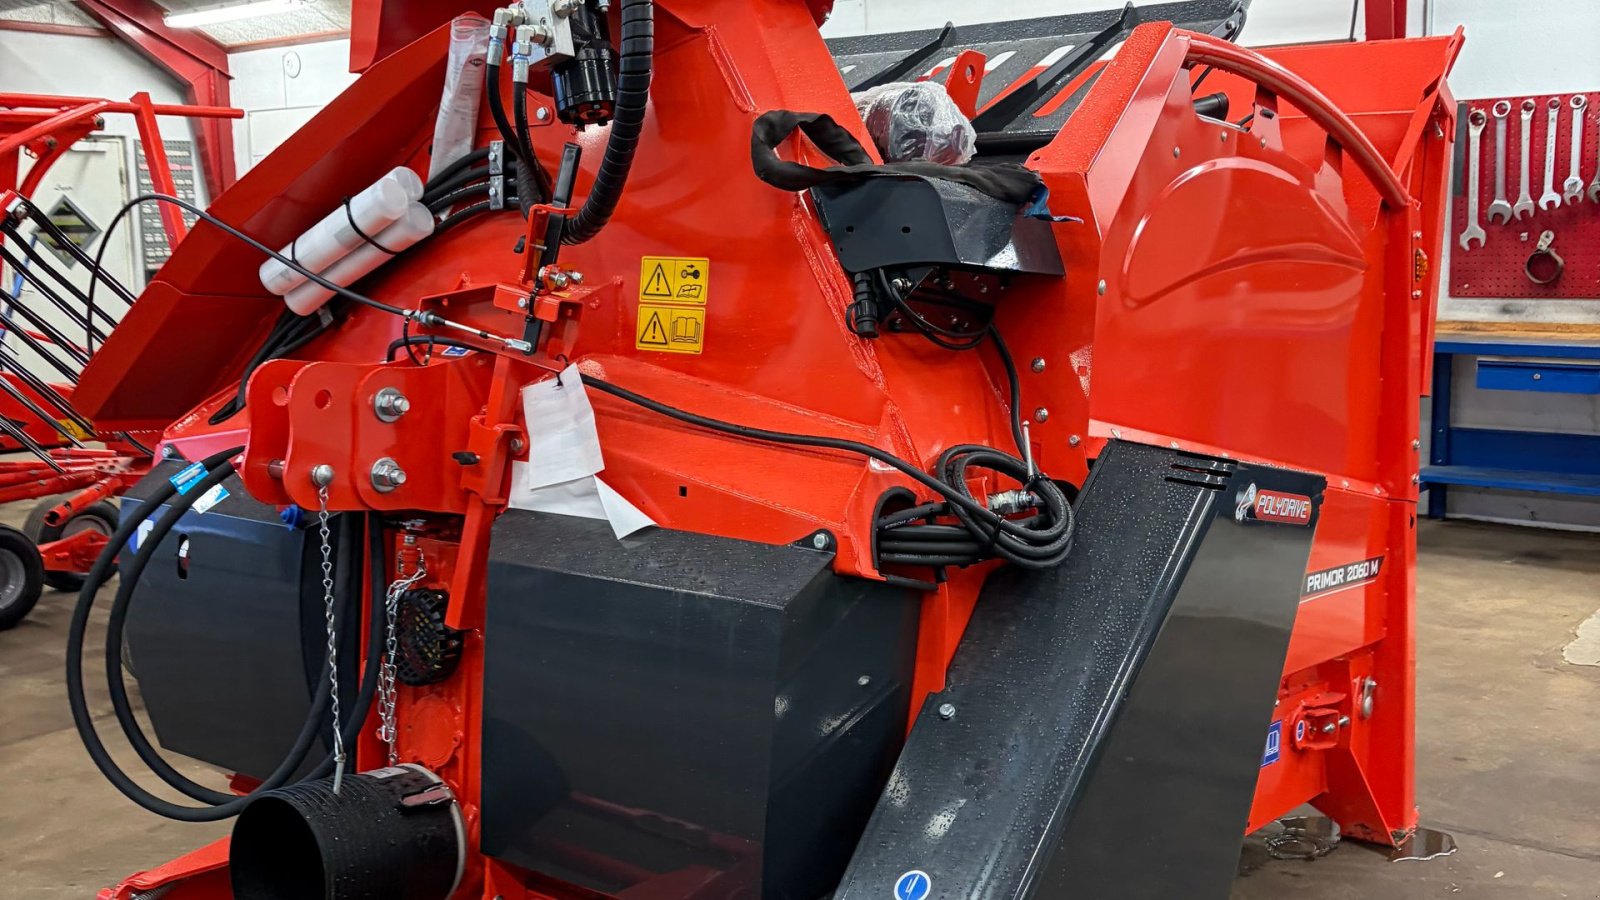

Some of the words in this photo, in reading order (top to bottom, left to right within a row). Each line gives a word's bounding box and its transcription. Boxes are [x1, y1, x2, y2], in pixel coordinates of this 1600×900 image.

[1256, 494, 1310, 518] POLYDRIVE
[1307, 567, 1344, 592] PRIMOR
[1346, 561, 1370, 581] 2060
[1370, 559, 1379, 576] M
